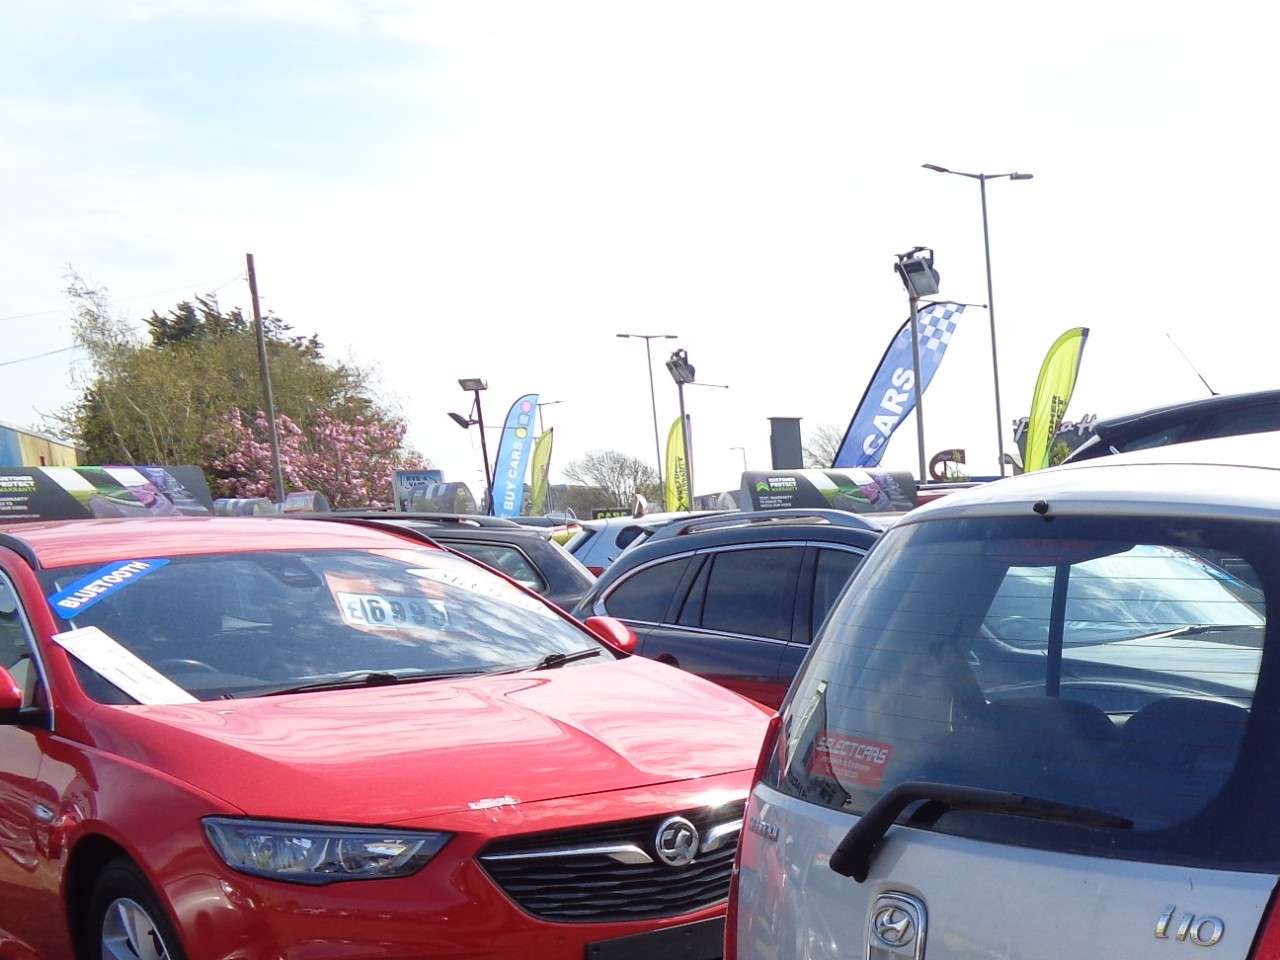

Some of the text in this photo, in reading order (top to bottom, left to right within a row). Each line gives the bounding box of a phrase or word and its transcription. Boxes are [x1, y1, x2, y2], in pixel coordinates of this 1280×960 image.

[863, 367, 916, 456] CARS
[508, 441, 523, 479] CARS
[504, 481, 516, 511] BUY
[57, 561, 152, 609] BLUETOOTH
[1154, 904, 1225, 947] i10
